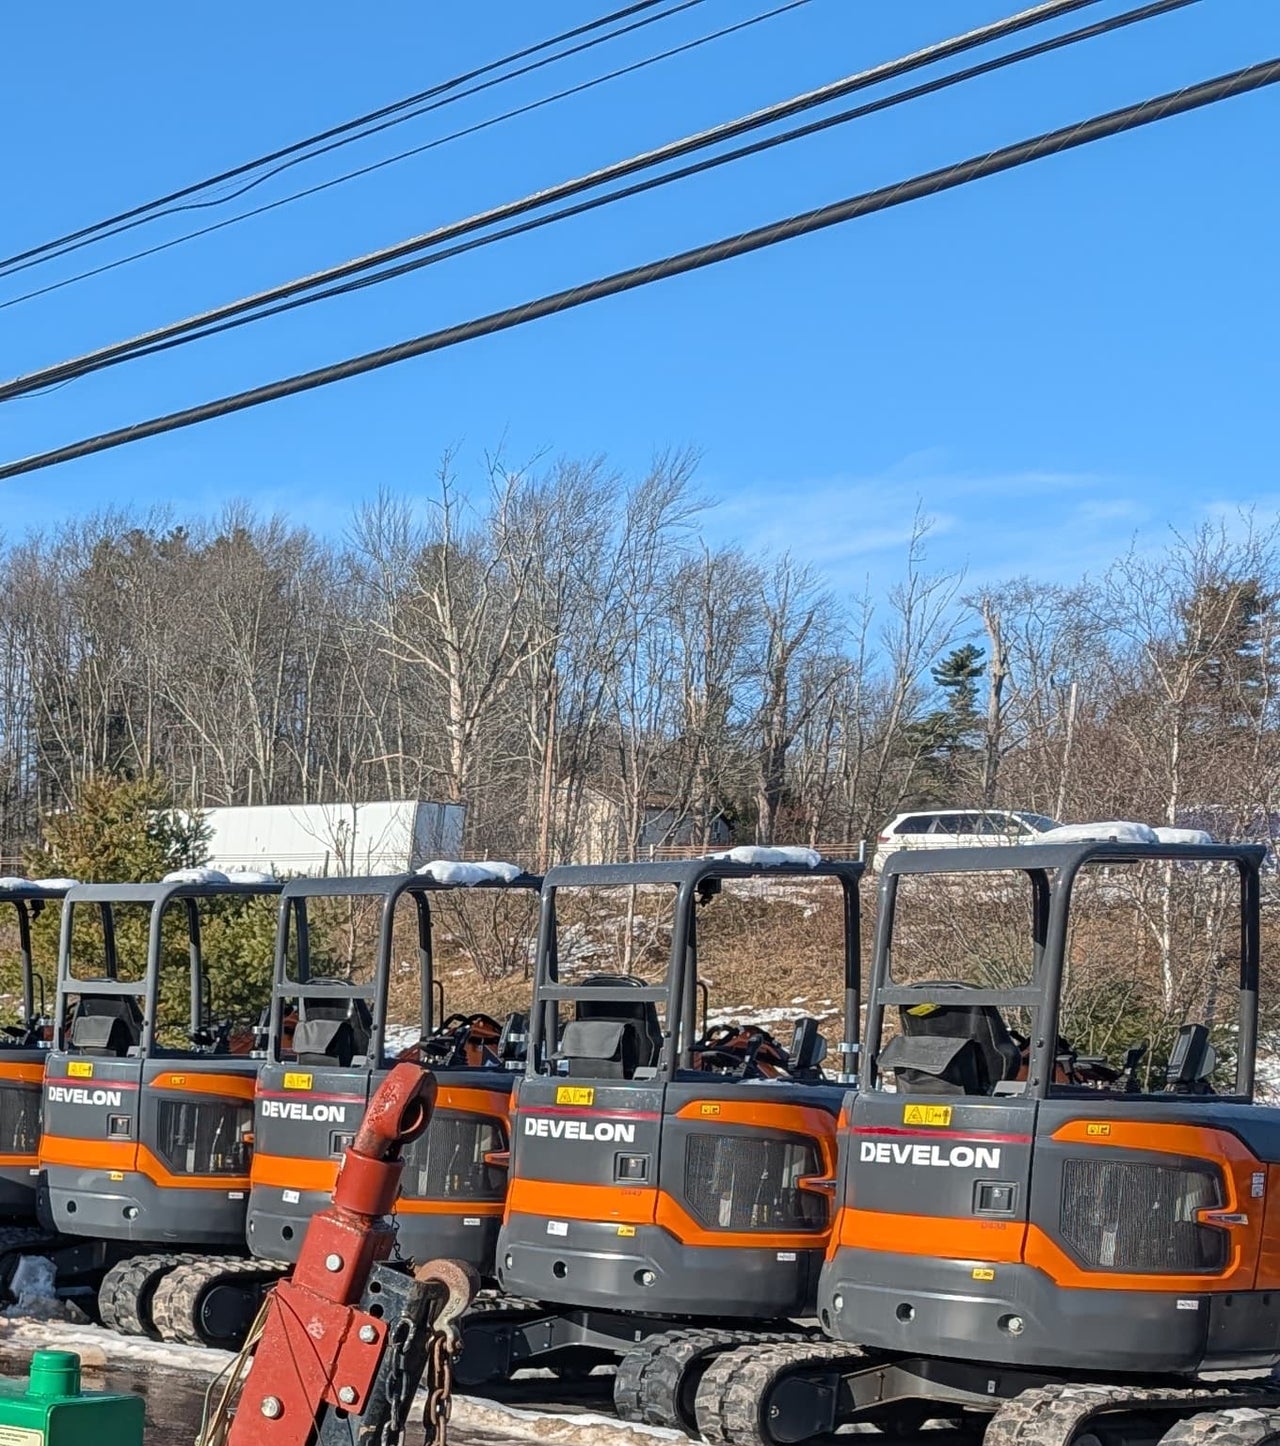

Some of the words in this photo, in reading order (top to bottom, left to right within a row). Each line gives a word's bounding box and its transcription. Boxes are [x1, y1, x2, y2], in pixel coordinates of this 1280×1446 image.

[48, 1086, 122, 1107] DEVELON
[261, 1100, 345, 1123] DEVELON
[524, 1117, 636, 1144] DEVELON
[860, 1141, 1001, 1169] DEVELON
